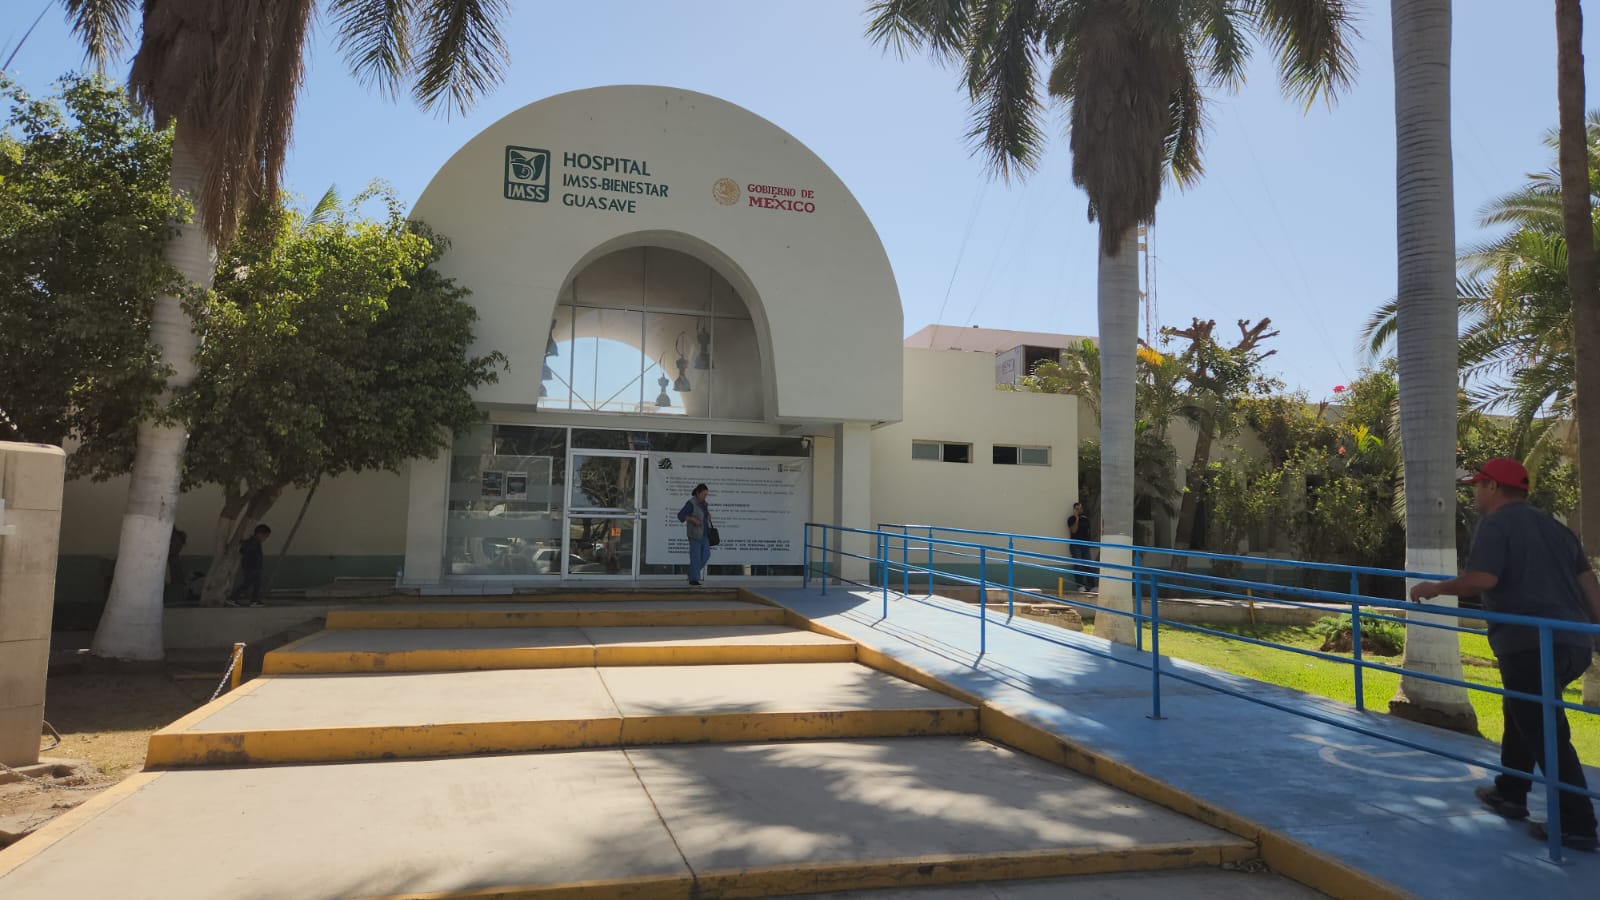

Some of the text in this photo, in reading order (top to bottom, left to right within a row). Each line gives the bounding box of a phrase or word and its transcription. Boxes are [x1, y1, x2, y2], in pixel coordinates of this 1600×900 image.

[563, 151, 651, 176] HOSPITAL
[507, 183, 546, 200] IMSS
[562, 173, 669, 198] IMSS-BIENESTAR
[747, 183, 814, 199] GOBIERNO DE
[562, 193, 636, 213] GUASAVE
[748, 195, 816, 213] MÉXICO
